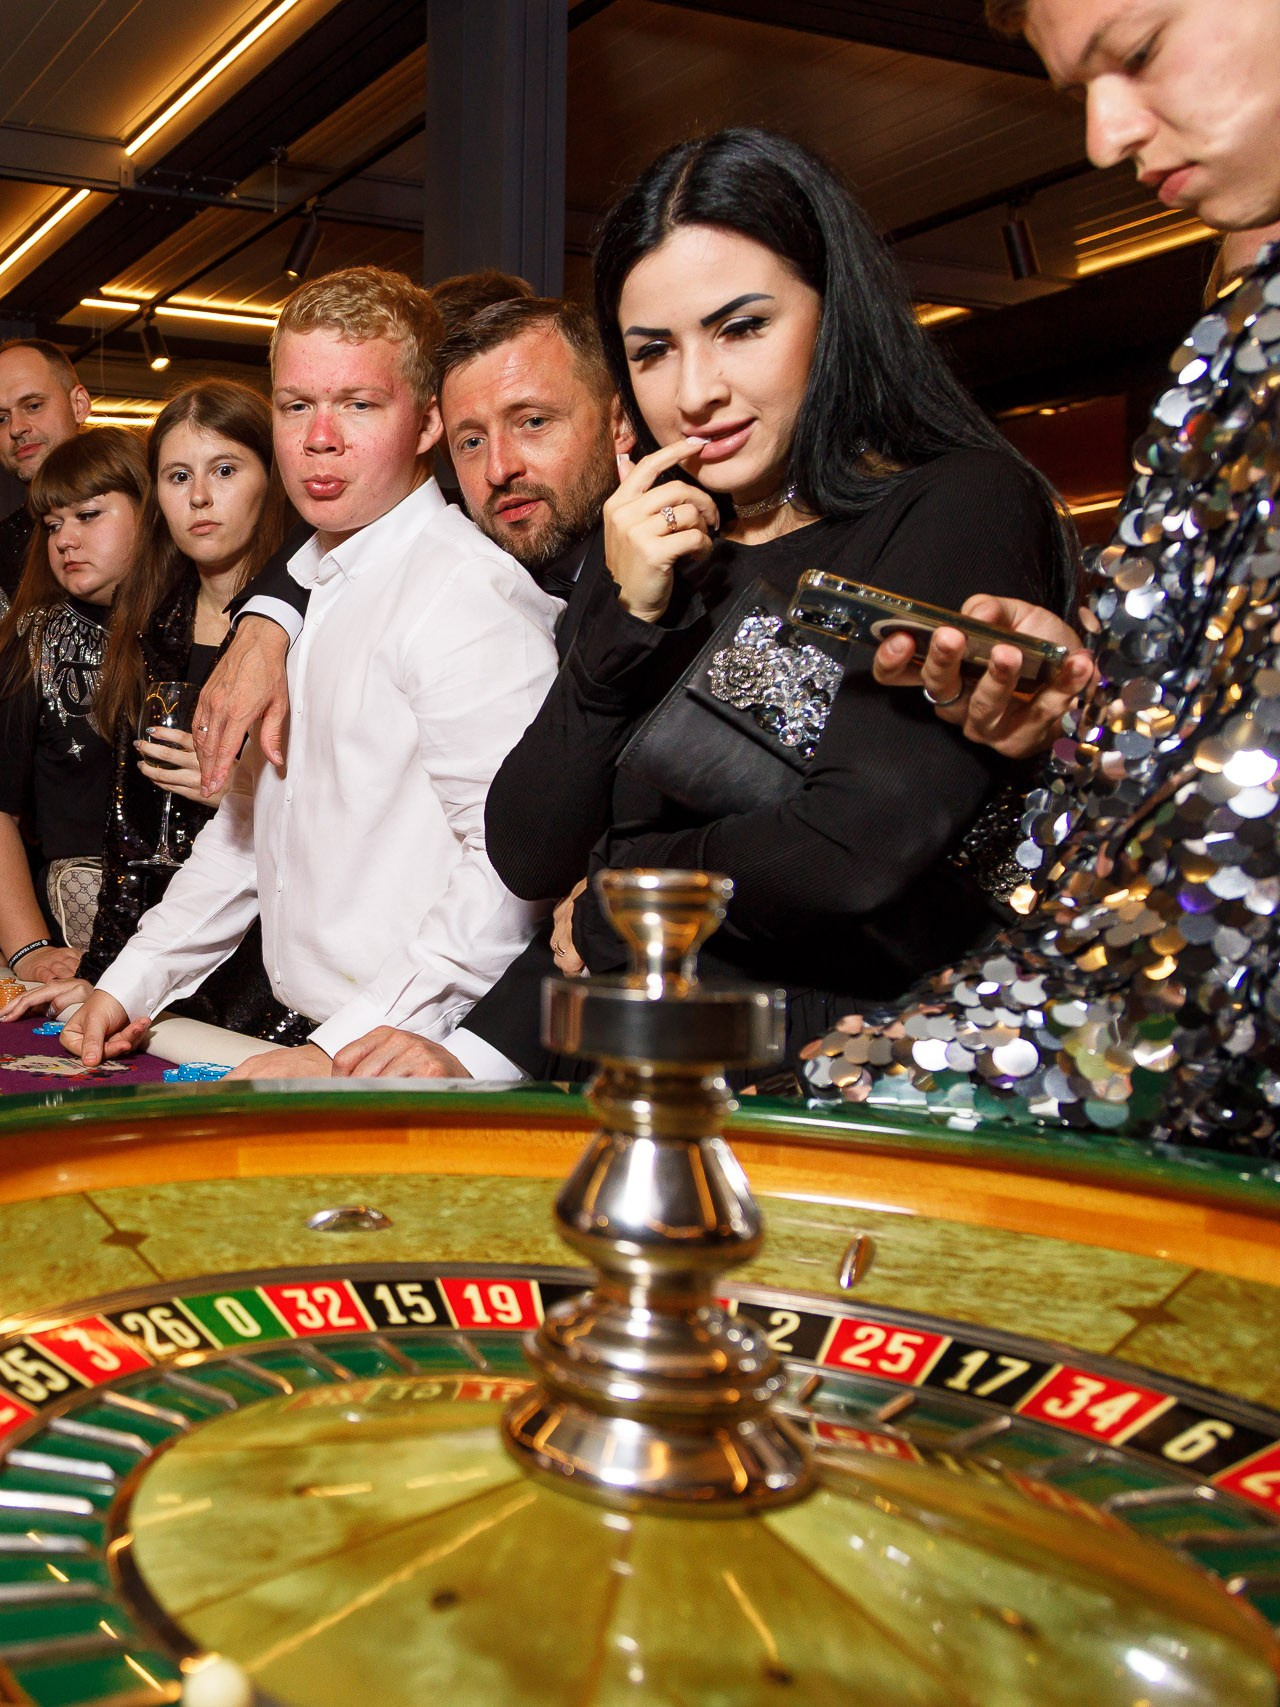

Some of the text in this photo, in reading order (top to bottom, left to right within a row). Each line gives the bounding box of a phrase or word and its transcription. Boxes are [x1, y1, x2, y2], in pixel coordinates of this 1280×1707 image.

[222, 1298, 260, 1338] 0
[293, 1285, 356, 1329] 32
[378, 1284, 436, 1324] 15
[462, 1282, 522, 1325] 19
[69, 1329, 120, 1371] 3
[127, 1308, 200, 1356] 26
[765, 1309, 802, 1352] 2
[841, 1327, 919, 1374] 25
[945, 1350, 1030, 1395] 17
[1043, 1379, 1138, 1431] 34
[1163, 1421, 1234, 1463] 6
